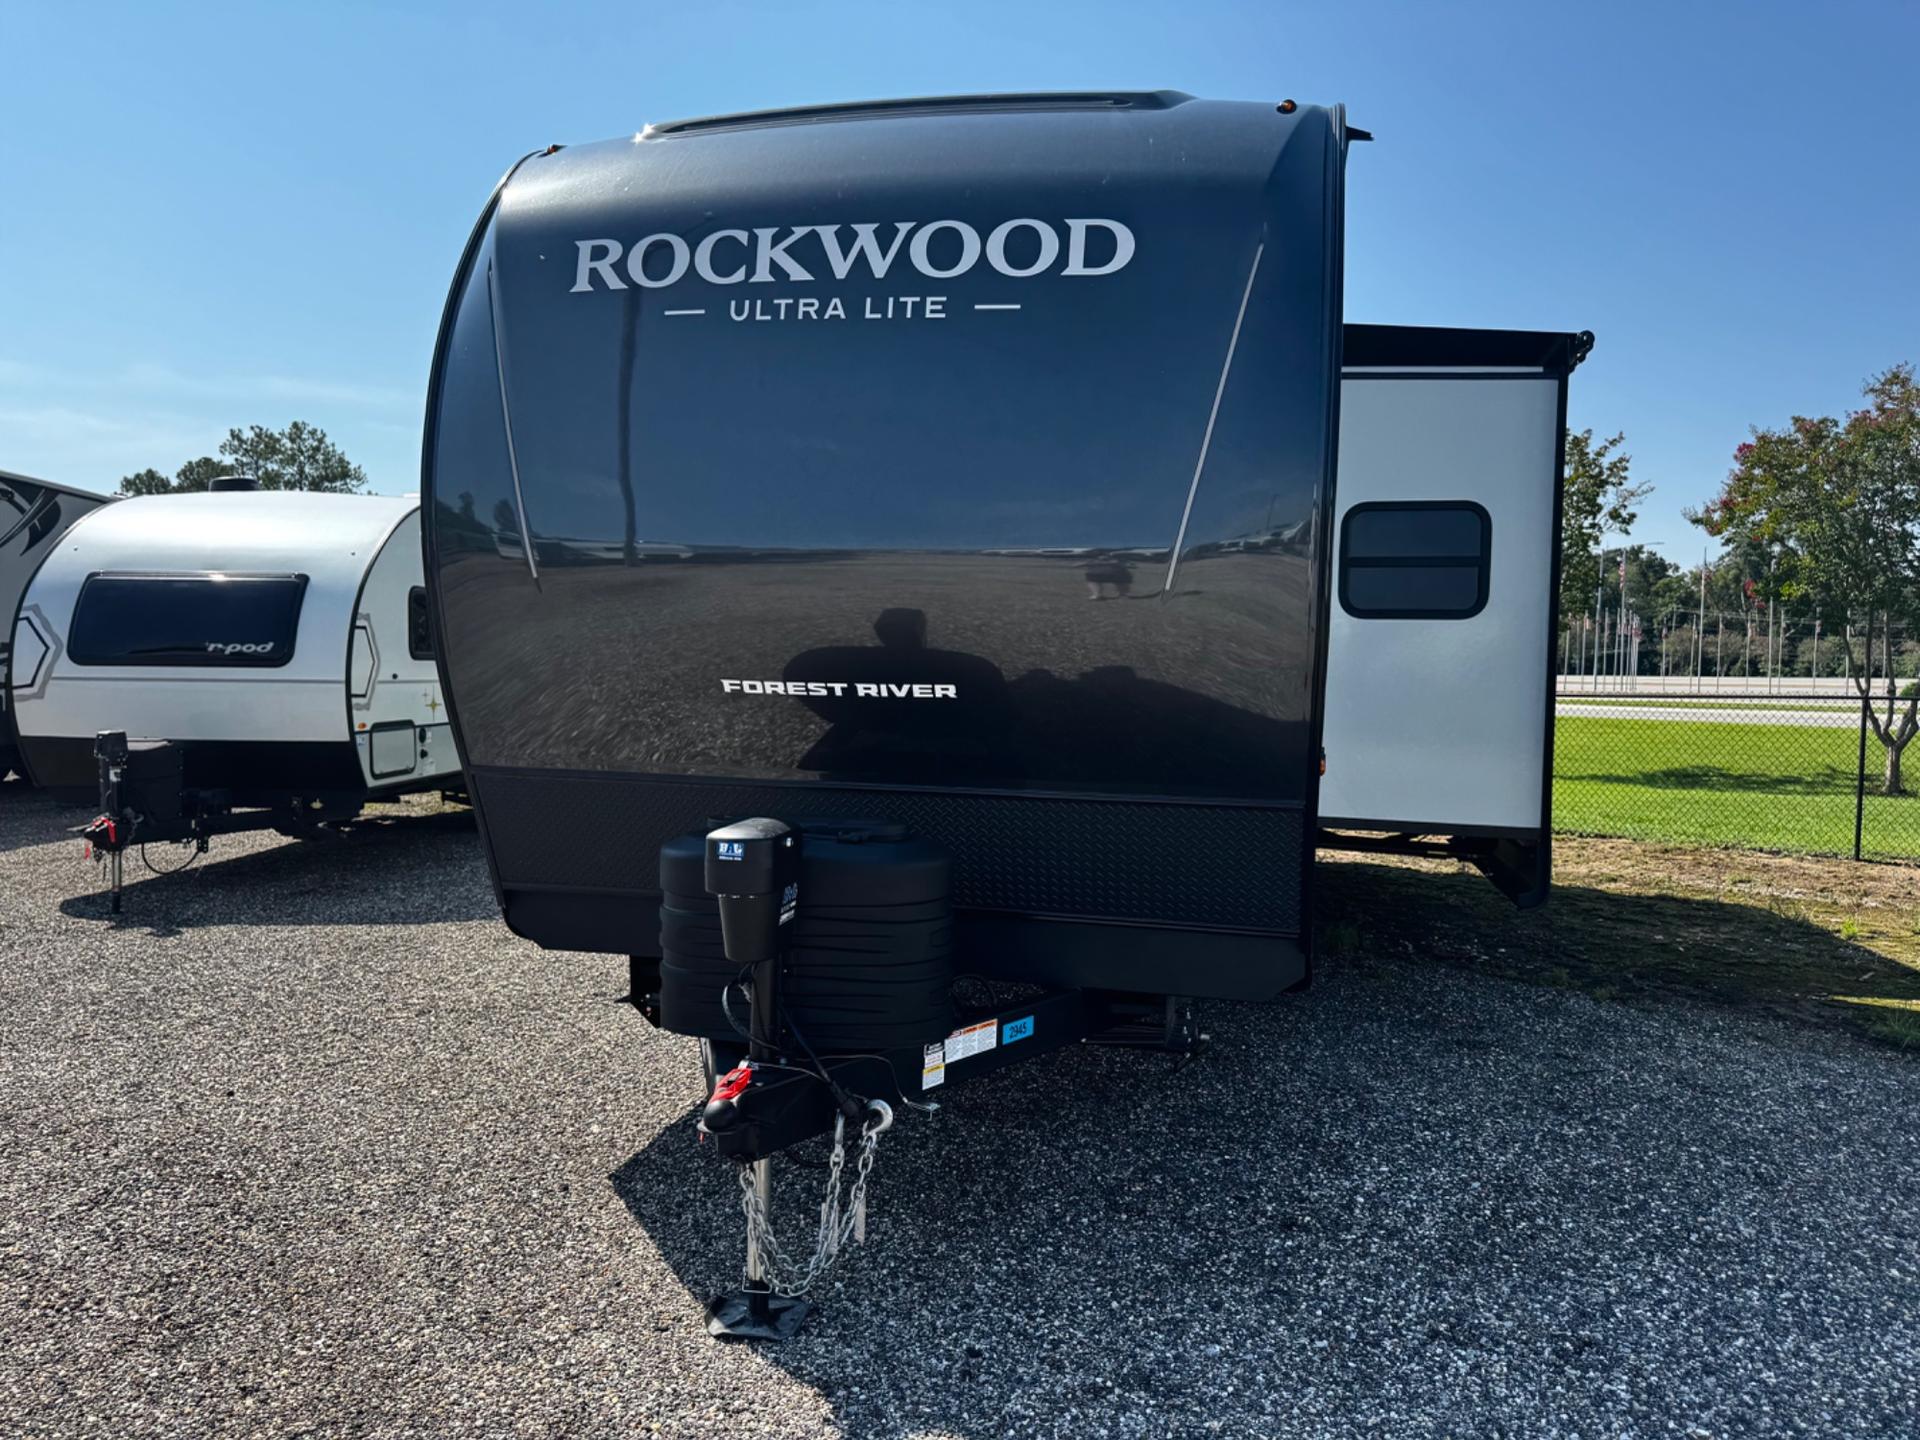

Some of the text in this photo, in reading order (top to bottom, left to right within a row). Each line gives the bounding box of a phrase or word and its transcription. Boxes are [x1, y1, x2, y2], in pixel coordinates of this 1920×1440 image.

[568, 217, 1137, 293] ROCKWOOD
[729, 296, 948, 322] ULTRA LITE
[720, 678, 958, 699] FOREST RIVER
[1009, 1021, 1027, 1039] 2945
